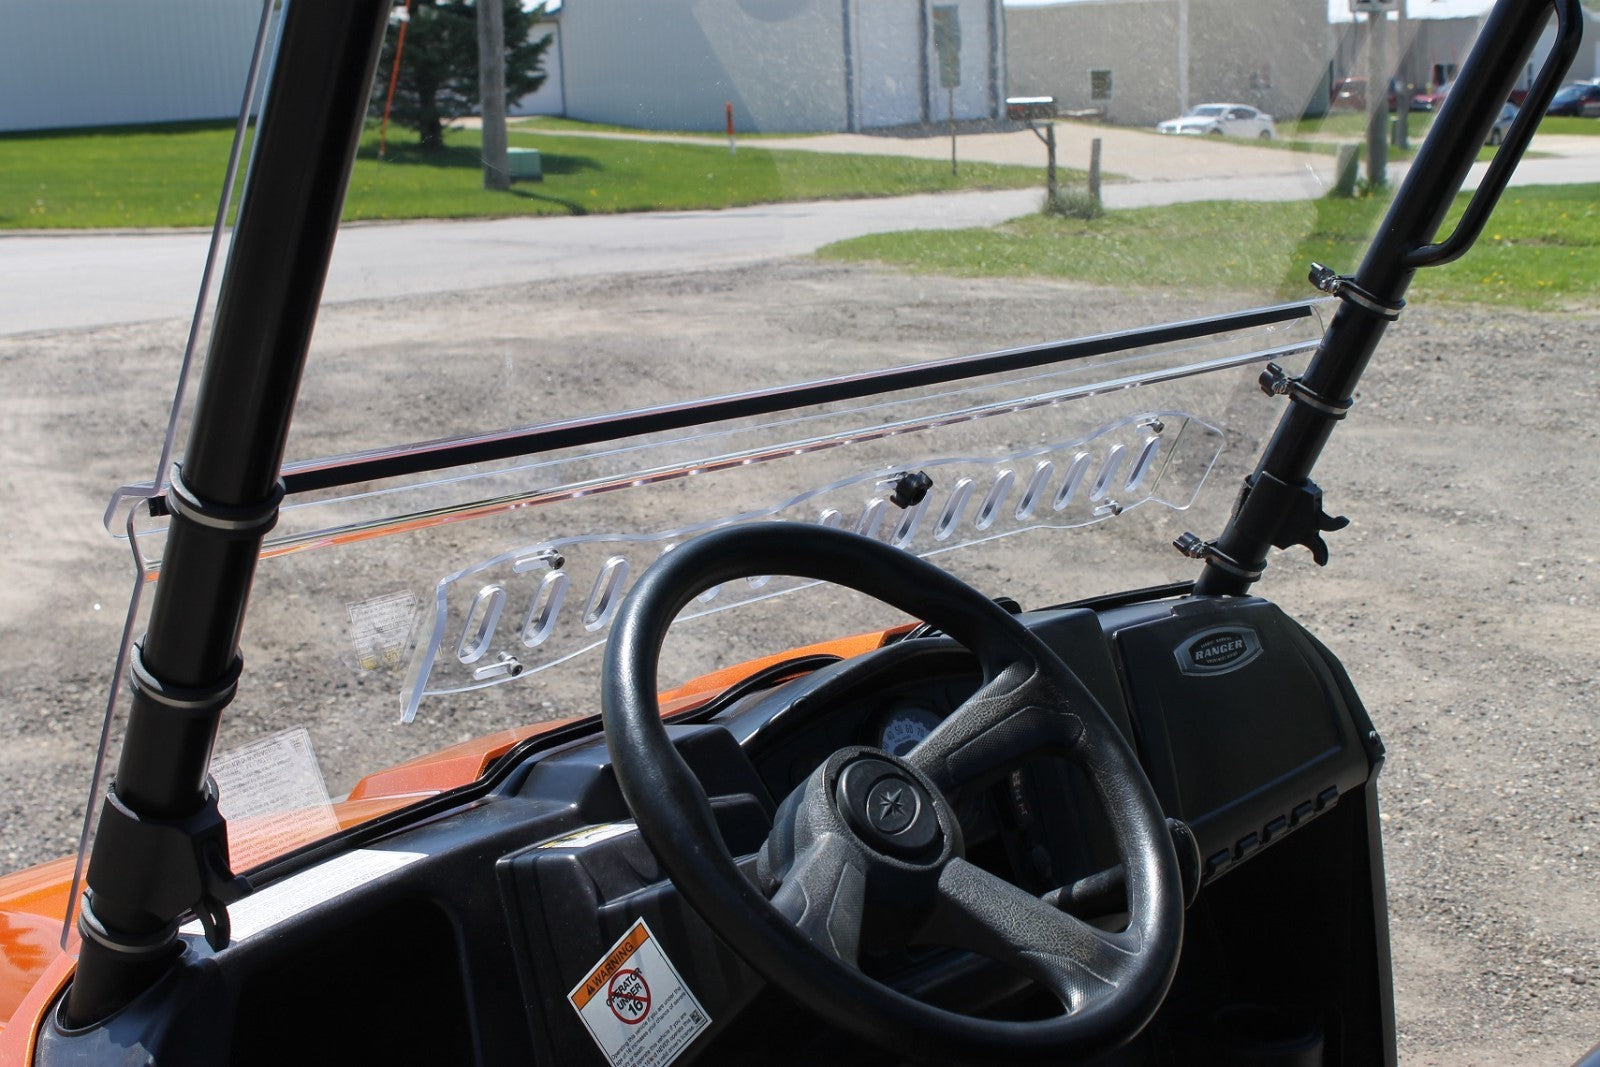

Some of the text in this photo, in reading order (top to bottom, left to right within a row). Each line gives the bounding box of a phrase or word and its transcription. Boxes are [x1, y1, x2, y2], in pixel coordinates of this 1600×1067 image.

[1195, 639, 1243, 660] RANGER
[592, 942, 633, 987] WARNING
[606, 967, 643, 1007] OPERATOR
[617, 983, 642, 1010] UNDER
[628, 997, 643, 1016] 16
[635, 1021, 648, 1035] vehicle
[664, 993, 674, 1005] under
[656, 1009, 669, 1023] chance
[657, 1030, 670, 1043] vehicle
[673, 1019, 681, 1028] you
[656, 1039, 670, 1054] NEVER
